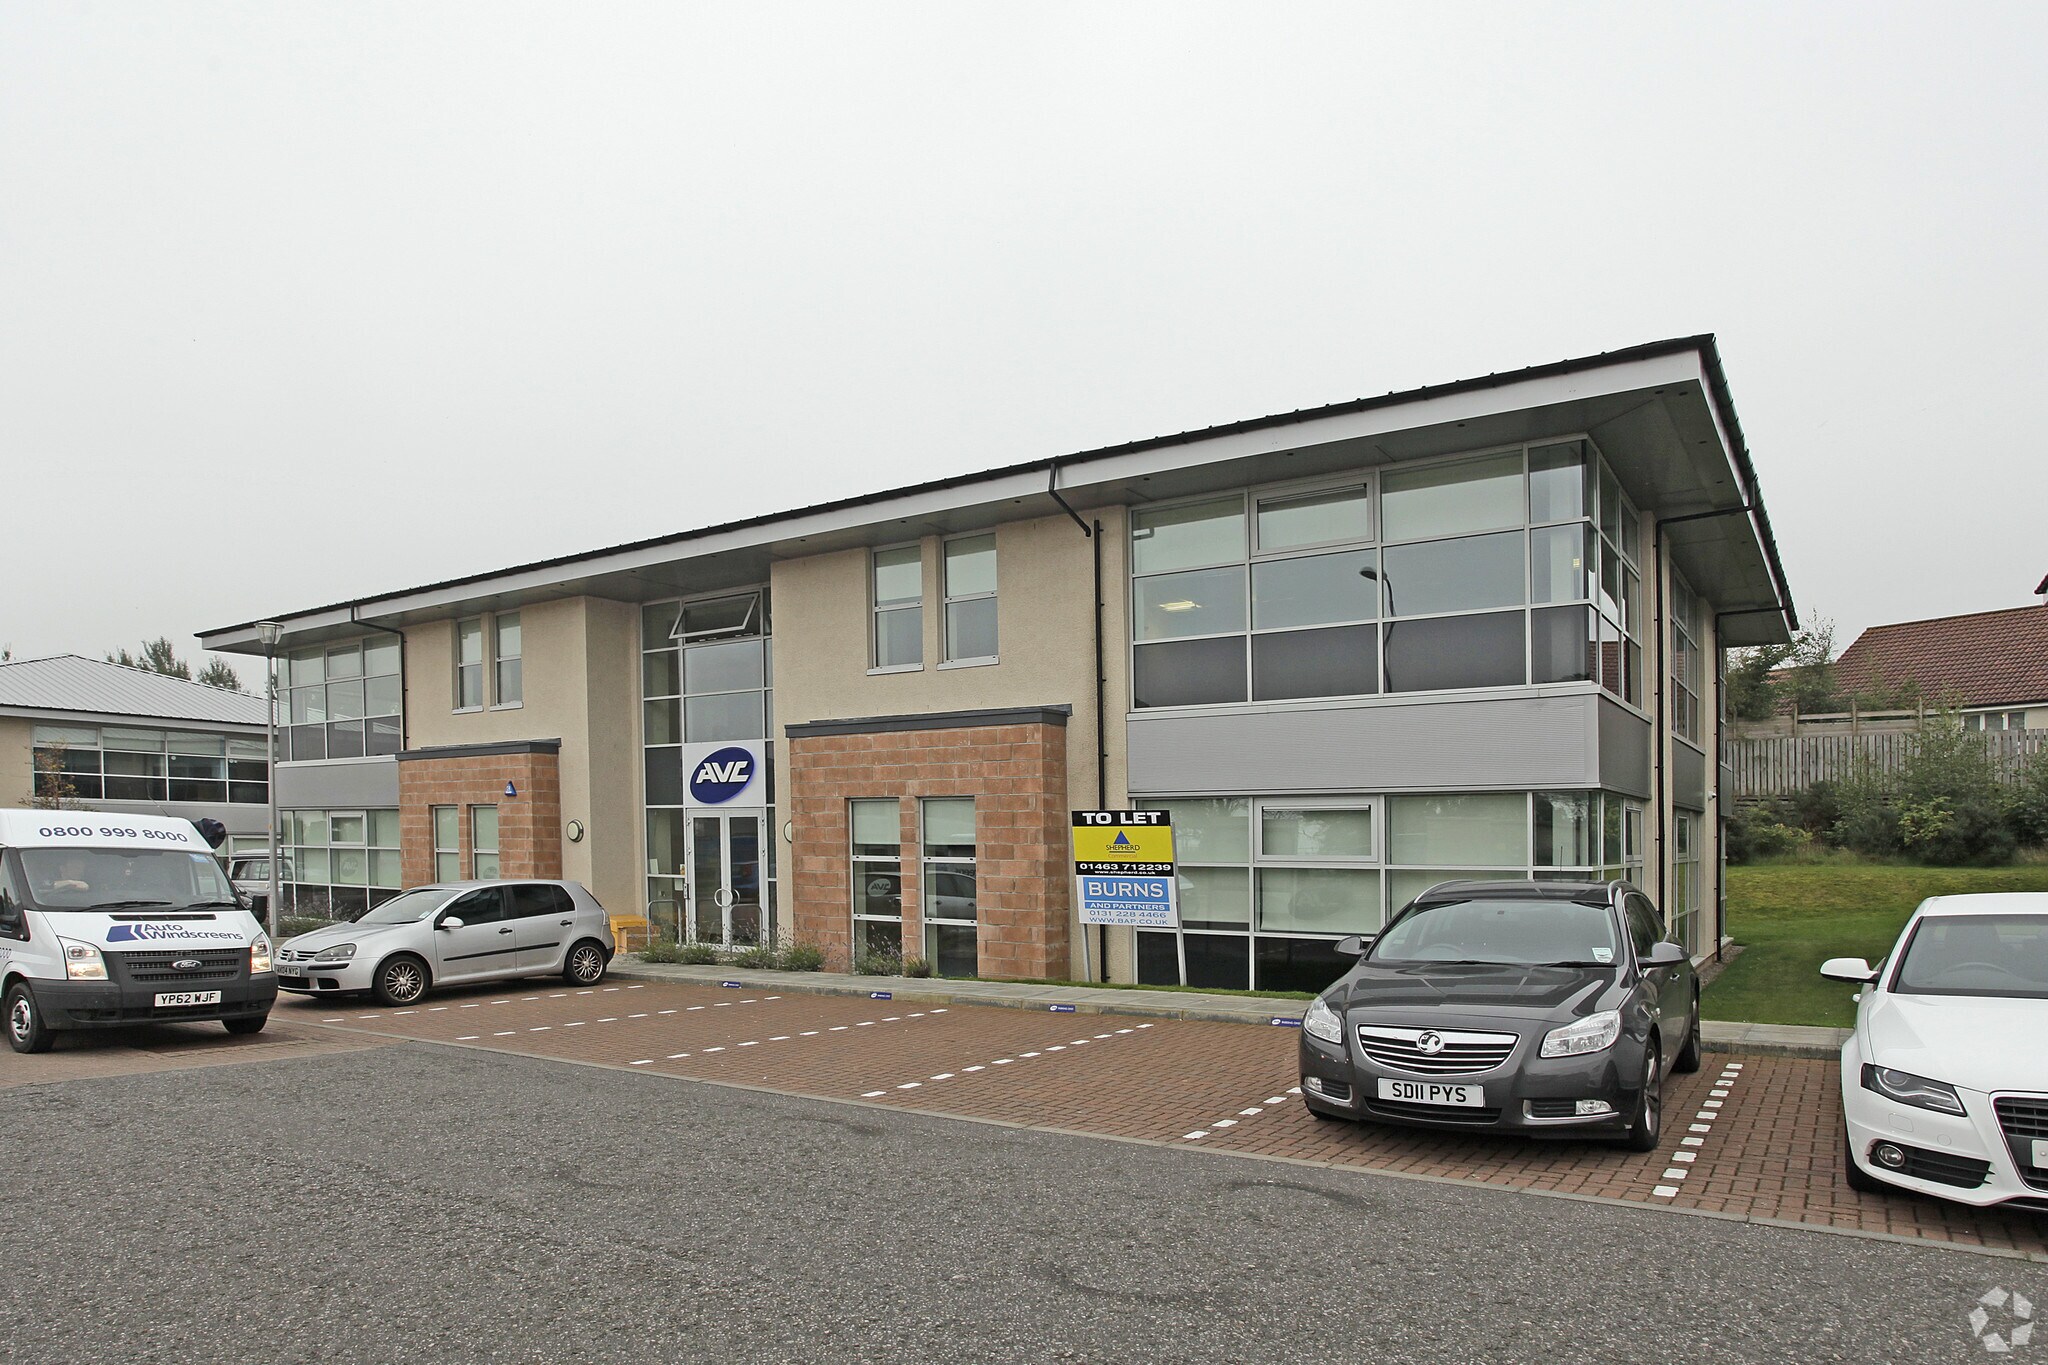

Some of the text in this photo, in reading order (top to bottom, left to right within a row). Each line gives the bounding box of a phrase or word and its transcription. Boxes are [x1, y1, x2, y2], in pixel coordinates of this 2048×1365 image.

[696, 761, 749, 784] AVC
[1082, 812, 1161, 825] TO LET
[39, 827, 188, 842] 0800 999 8000
[1122, 863, 1171, 871] 712239
[1088, 881, 1164, 898] BURNS
[1112, 903, 1165, 911] PARTNERS
[144, 923, 183, 932] Auto
[1089, 917, 1168, 925] WWW.BAP.CO.UK
[145, 930, 243, 940] Windscreens
[161, 992, 216, 1005] YP62 WJF
[1392, 1082, 1467, 1103] SD11 PYS
